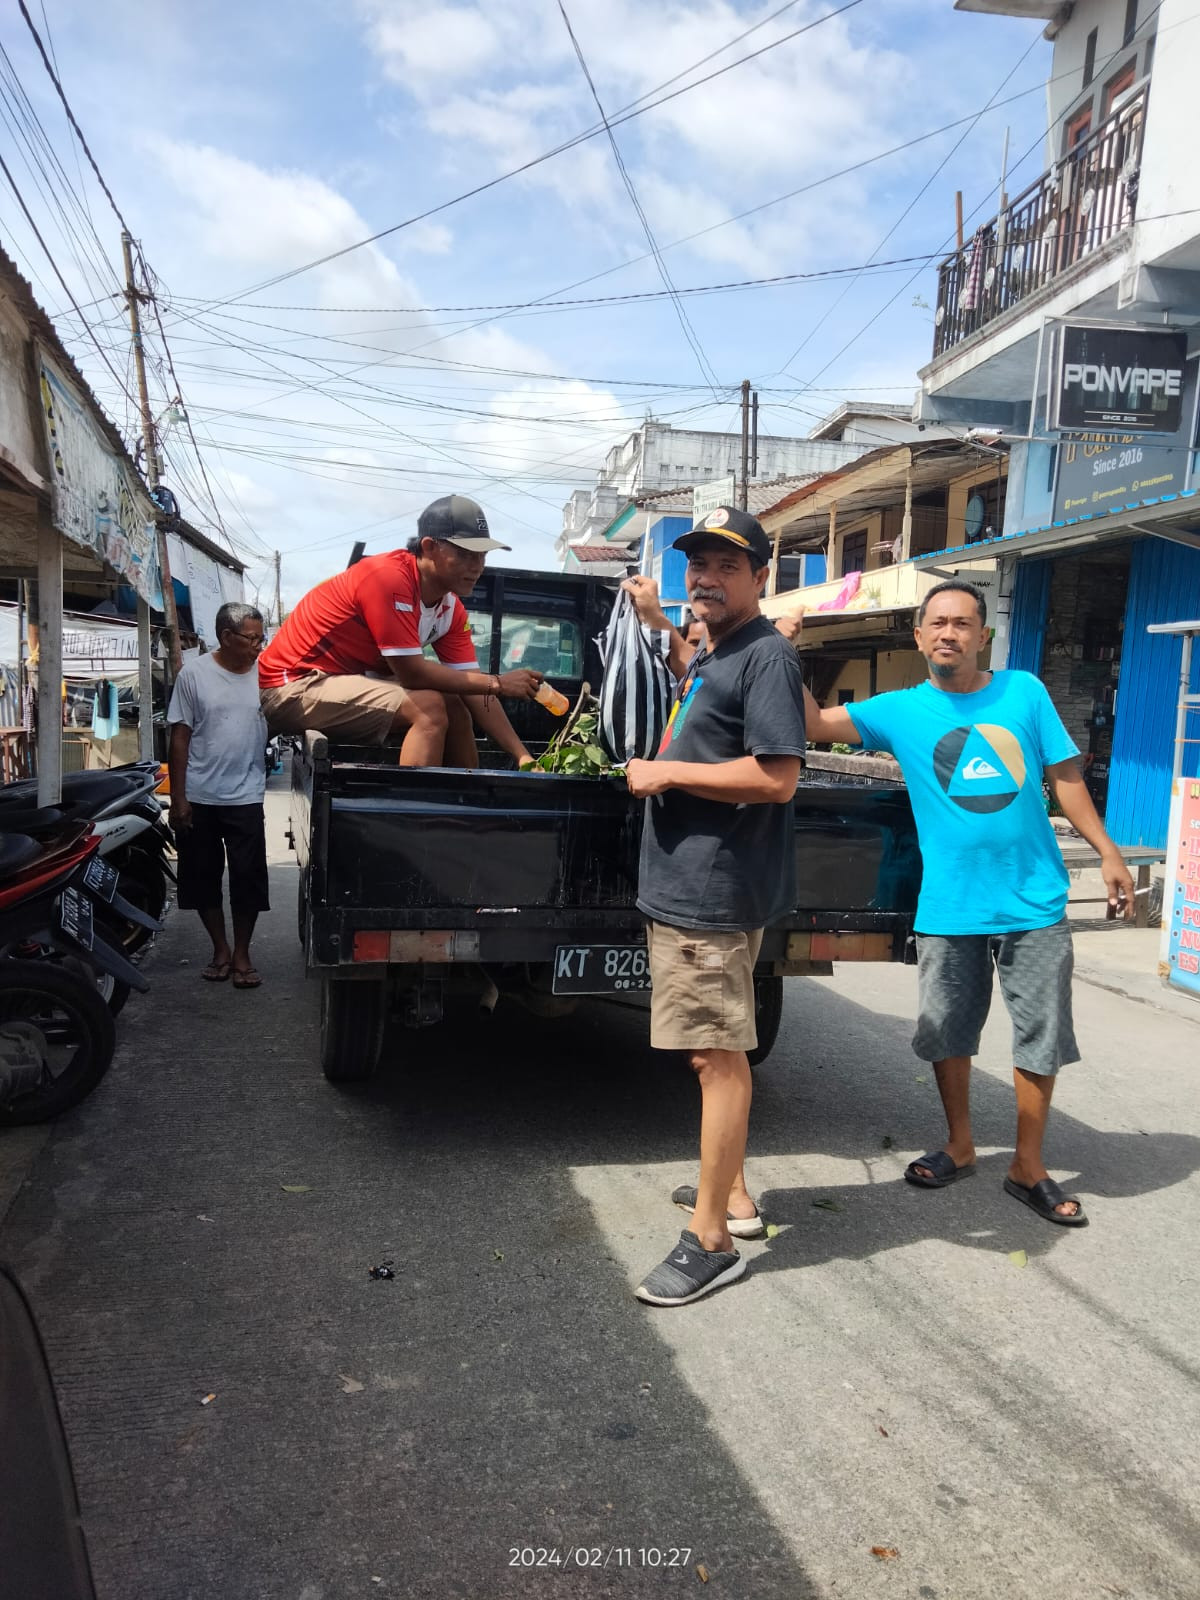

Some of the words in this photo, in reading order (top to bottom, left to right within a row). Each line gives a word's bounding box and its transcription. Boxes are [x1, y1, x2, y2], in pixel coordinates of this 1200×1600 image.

[1064, 363, 1182, 396] PONVAPE
[1092, 457, 1117, 476] Since
[1118, 447, 1143, 469] 2016
[557, 948, 590, 978] KT
[604, 949, 652, 978] 826
[1178, 952, 1199, 974] ES
